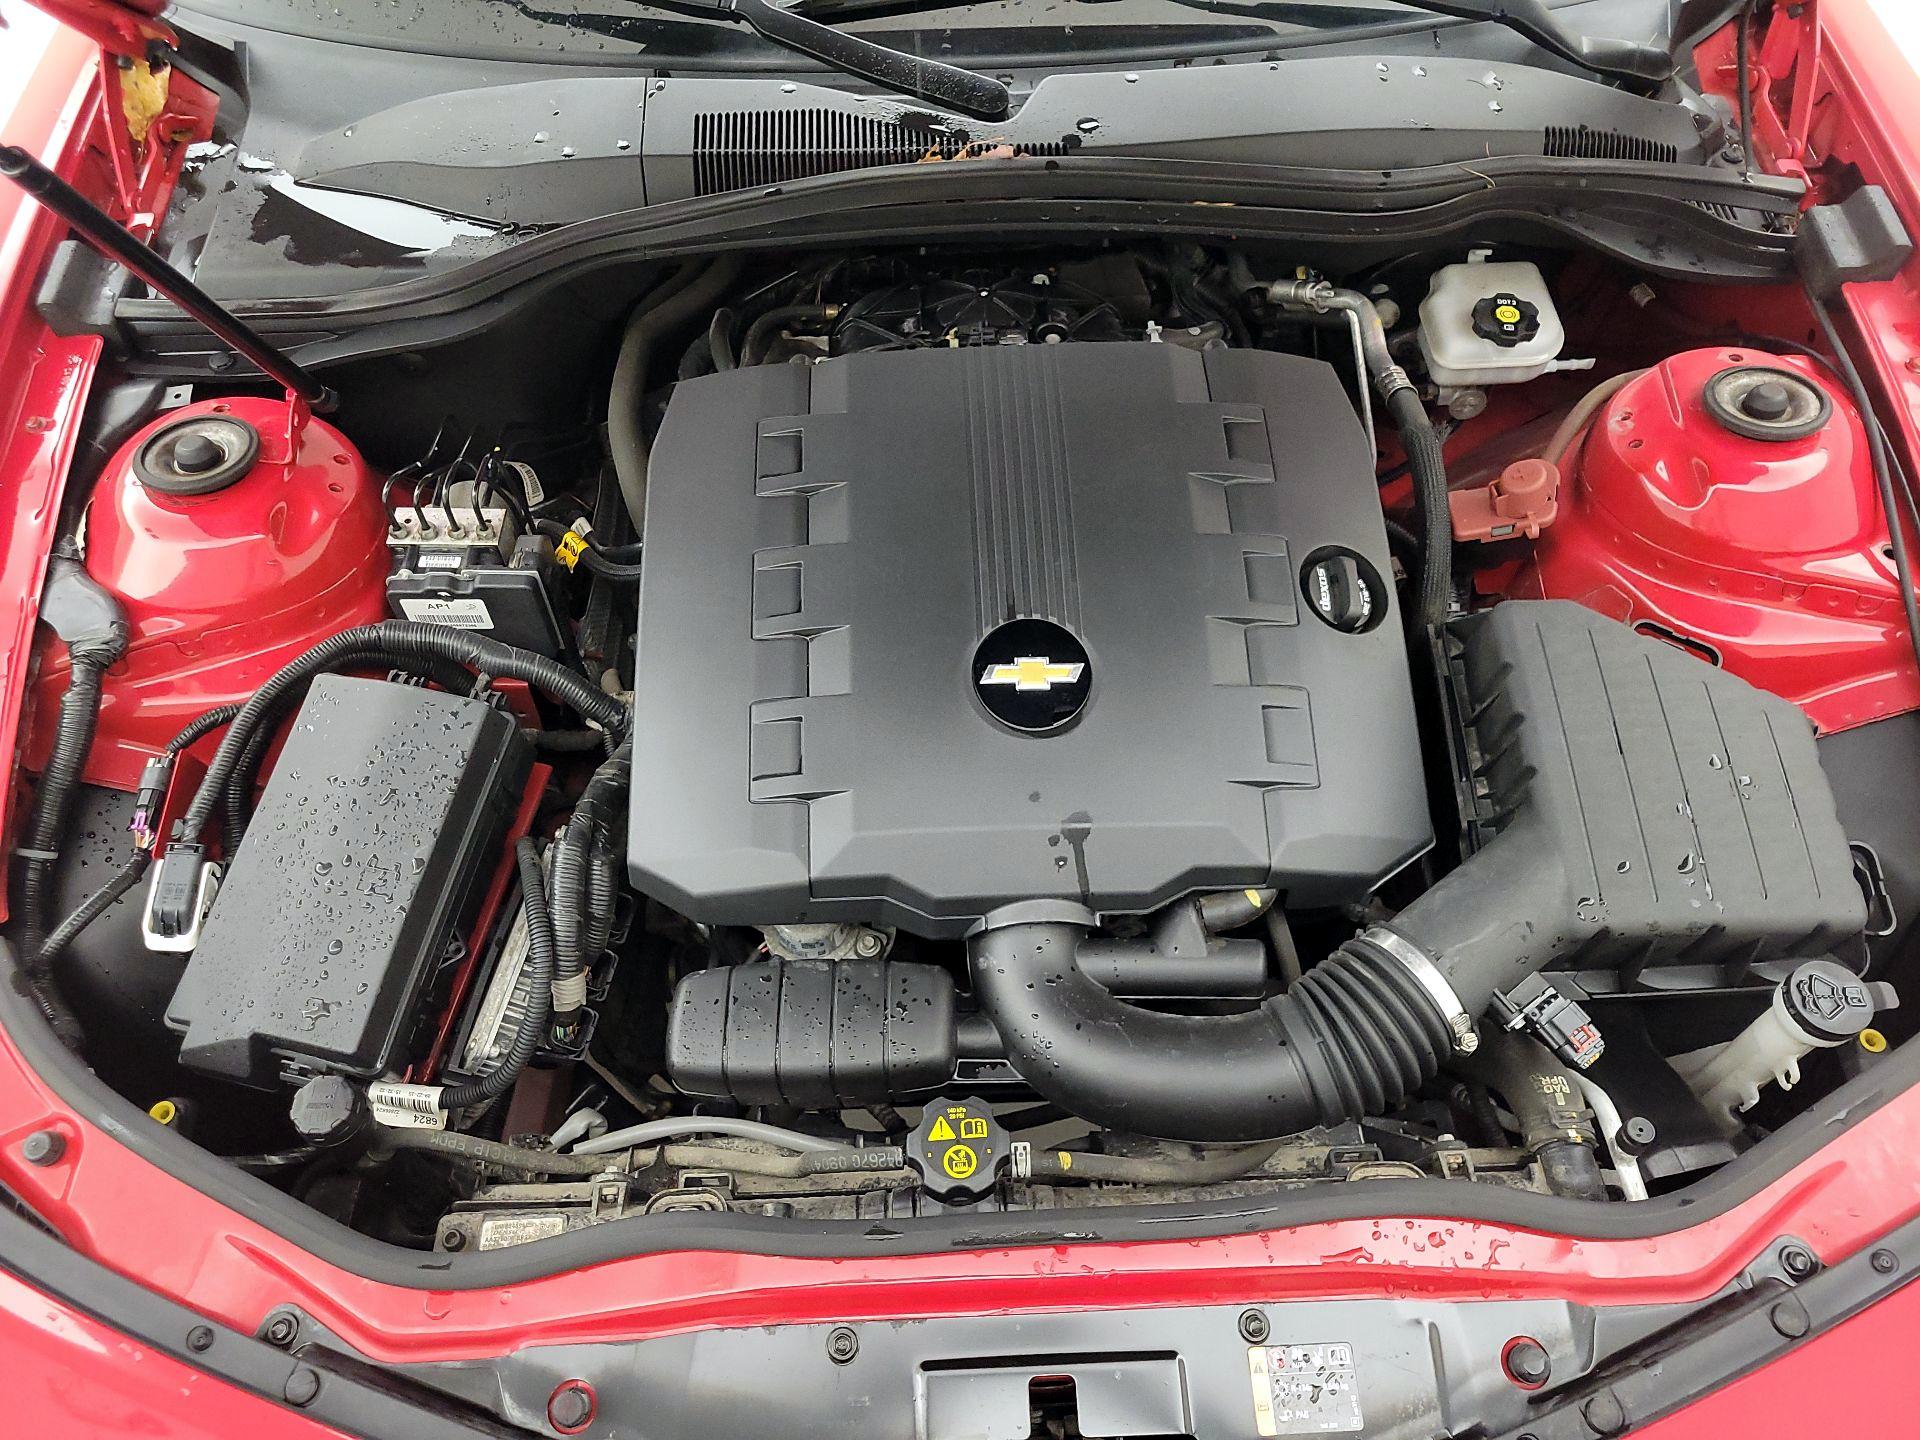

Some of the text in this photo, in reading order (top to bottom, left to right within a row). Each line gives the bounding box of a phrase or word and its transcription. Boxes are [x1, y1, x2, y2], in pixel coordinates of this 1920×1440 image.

[1316, 565, 1332, 611] dexos
[1540, 1075, 1566, 1087] UPR
[1544, 1082, 1571, 1095] RAD
[413, 1113, 438, 1126] 6824
[430, 1131, 466, 1151] EPDM
